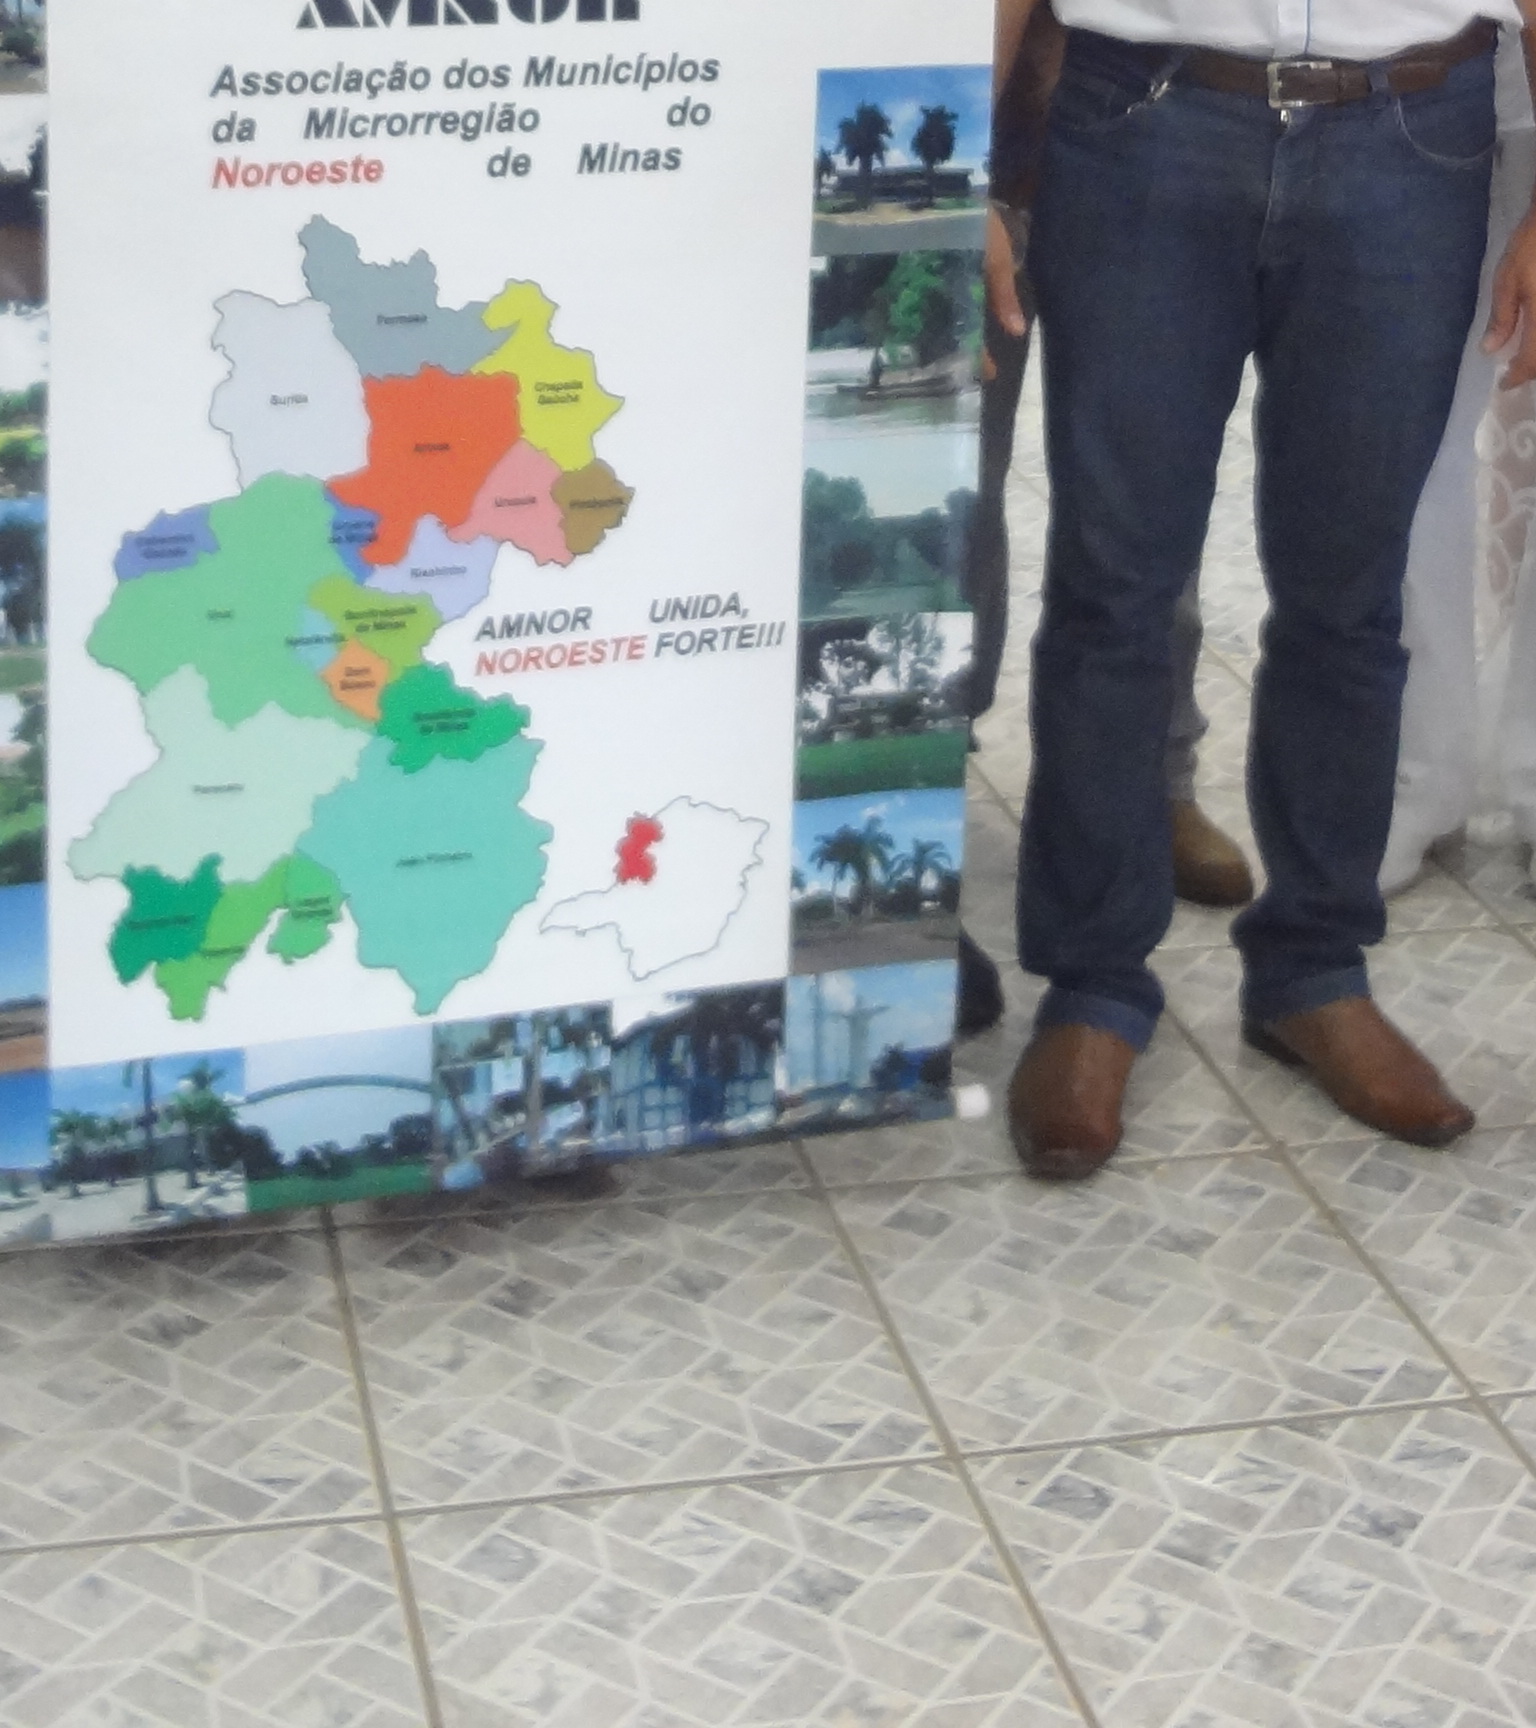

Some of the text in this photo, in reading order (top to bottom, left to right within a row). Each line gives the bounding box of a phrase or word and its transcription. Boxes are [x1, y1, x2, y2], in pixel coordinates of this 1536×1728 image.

[210, 52, 721, 100] Associação dos Municípios
[212, 96, 712, 143] da Microrregião do
[212, 143, 683, 189] Noroeste de Minas
[474, 592, 749, 641] AMNOR UNIDA,
[475, 635, 649, 676] NOROESTE
